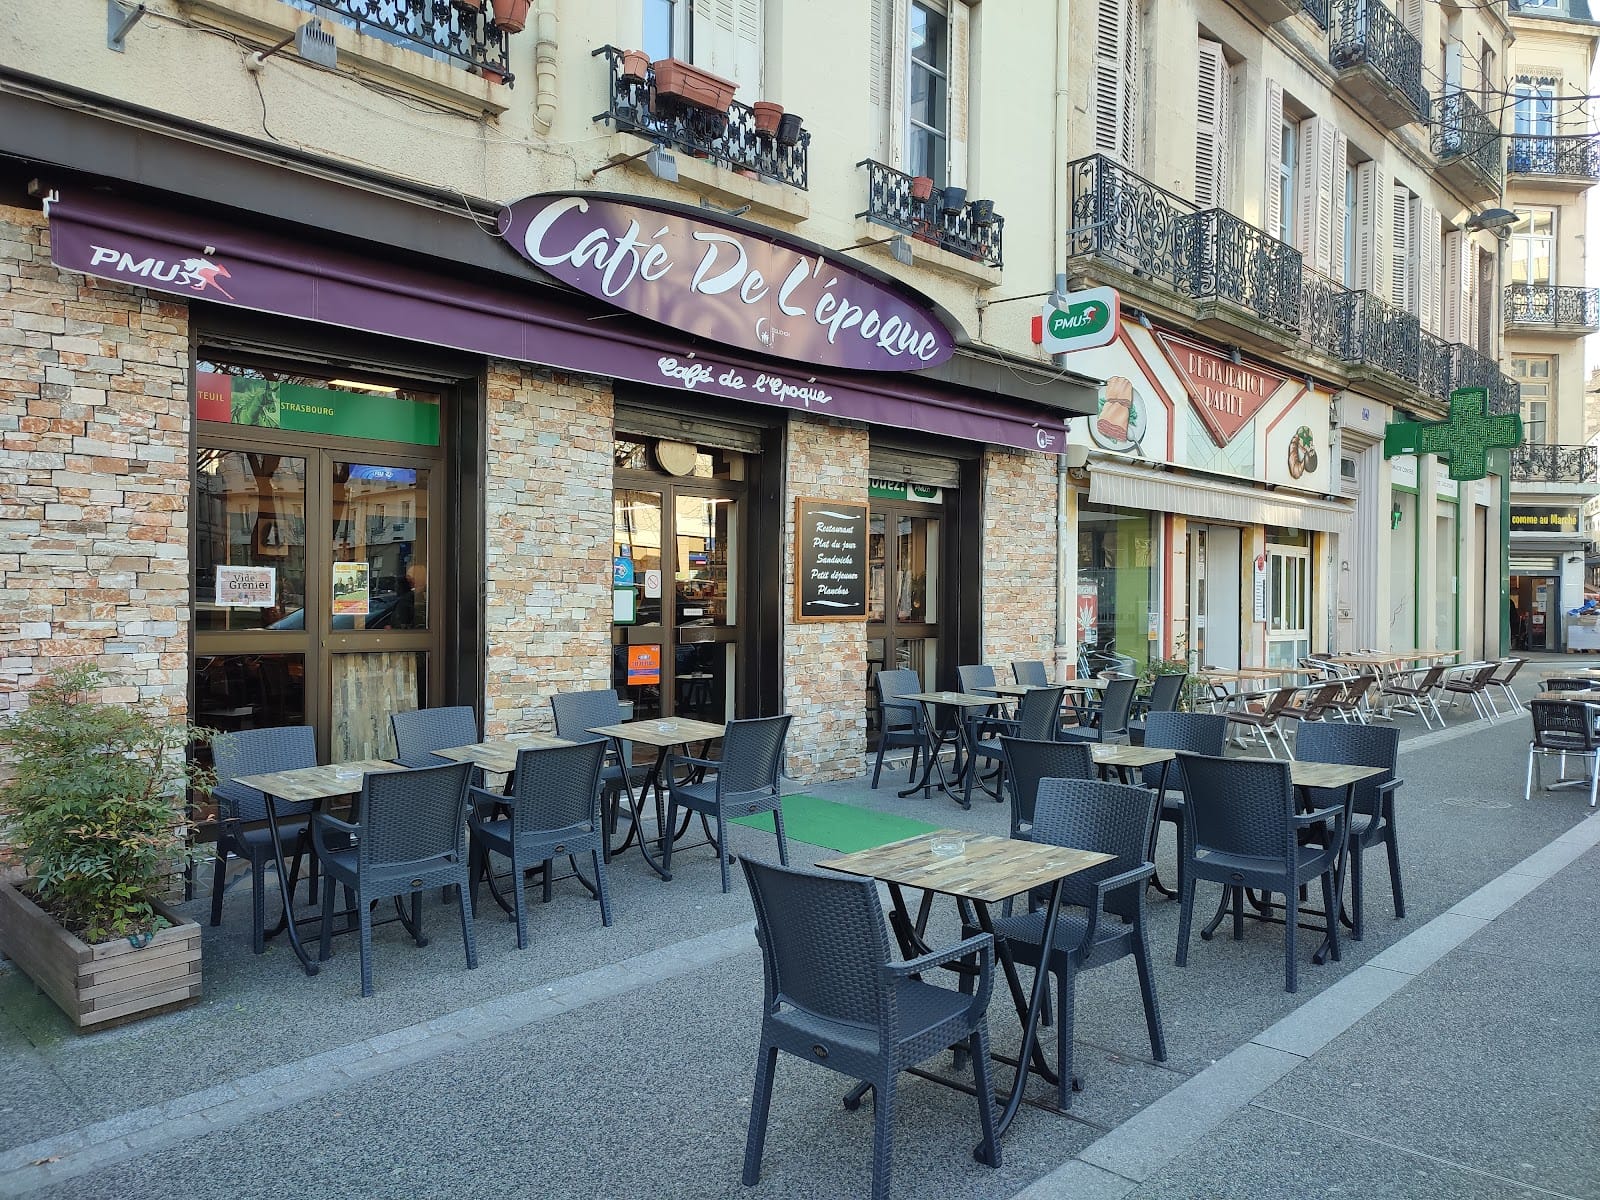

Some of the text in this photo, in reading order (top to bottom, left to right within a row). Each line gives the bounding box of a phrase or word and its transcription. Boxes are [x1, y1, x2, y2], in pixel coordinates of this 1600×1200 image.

[524, 197, 674, 298] Café
[689, 231, 770, 305] De
[90, 245, 180, 281] PMU
[1053, 315, 1082, 331] PMU
[658, 357, 714, 388] Café
[719, 369, 747, 389] de
[1189, 352, 1264, 397] RESTAURATION
[1205, 386, 1244, 417] RAPIDE
[280, 402, 334, 416] STRASBOURG
[868, 480, 905, 491] ouez!
[1511, 513, 1577, 525] comme au Marché
[816, 521, 854, 534] Restaurant
[812, 537, 857, 551] Plat du jour
[816, 553, 853, 564] Sandwichs
[234, 573, 256, 582] Vide
[811, 568, 858, 582] Petit déjeuner
[229, 581, 270, 590] Grenier
